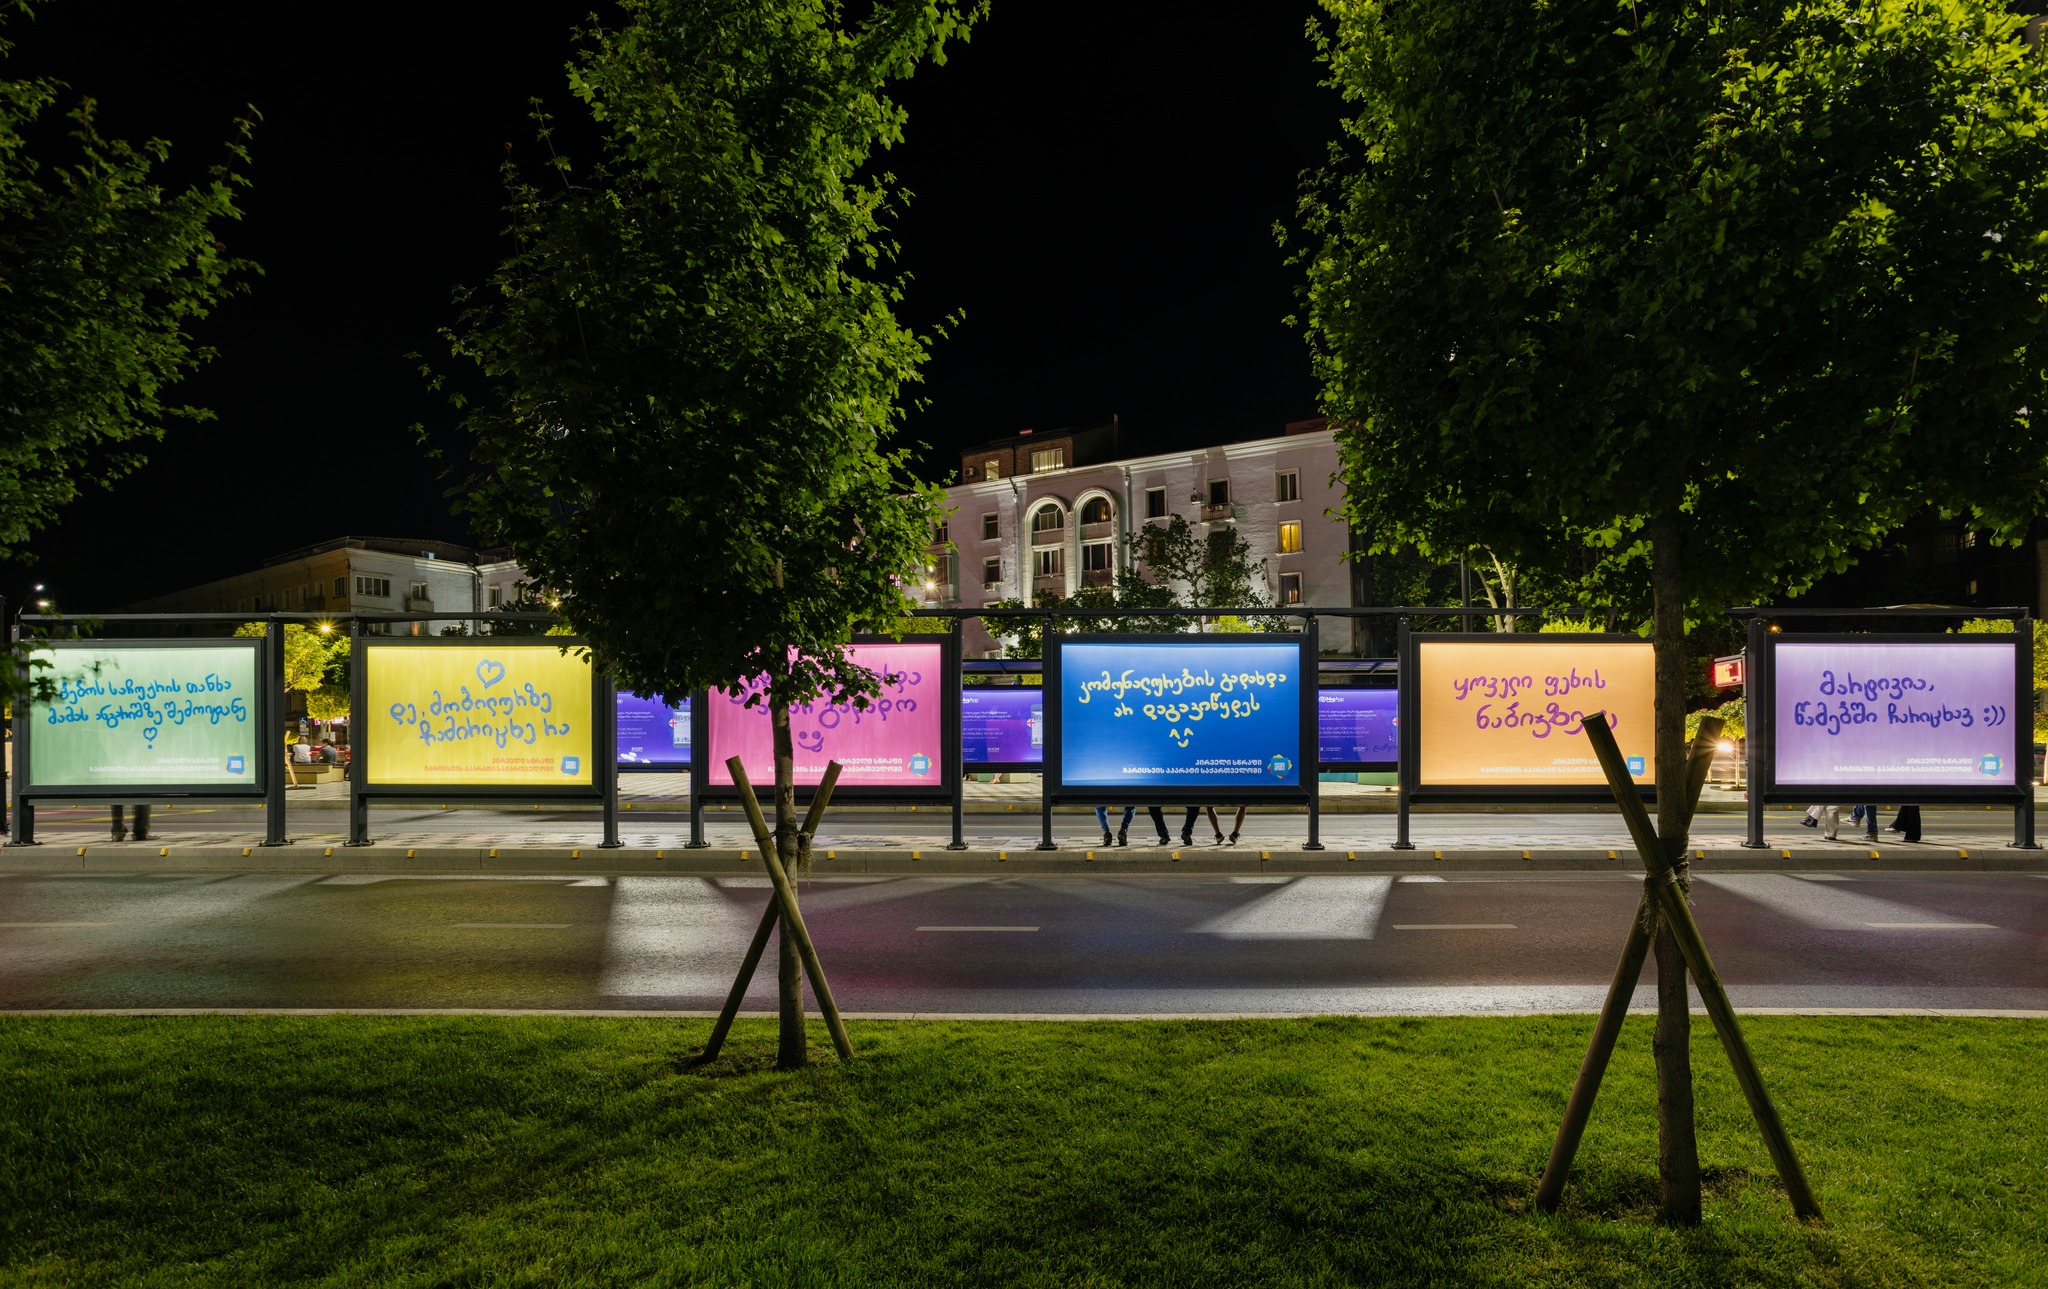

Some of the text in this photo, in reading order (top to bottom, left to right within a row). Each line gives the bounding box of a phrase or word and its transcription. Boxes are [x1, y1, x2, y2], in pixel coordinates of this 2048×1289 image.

[109, 678, 181, 702] საჩუქრის
[186, 673, 232, 694] თანხა
[430, 682, 553, 716] მობილურზე
[1079, 668, 1287, 704] კომუნალურების გადახდა
[1454, 668, 1606, 700] ყოველი ფეხის
[1819, 670, 1935, 701] მარტივია,
[48, 706, 89, 725] მამას
[1114, 702, 1133, 717] არ
[1794, 701, 1878, 735] წამებში
[1888, 702, 1974, 728] ჩარიცხავ
[419, 715, 570, 748] ჩამირიცხე რა
